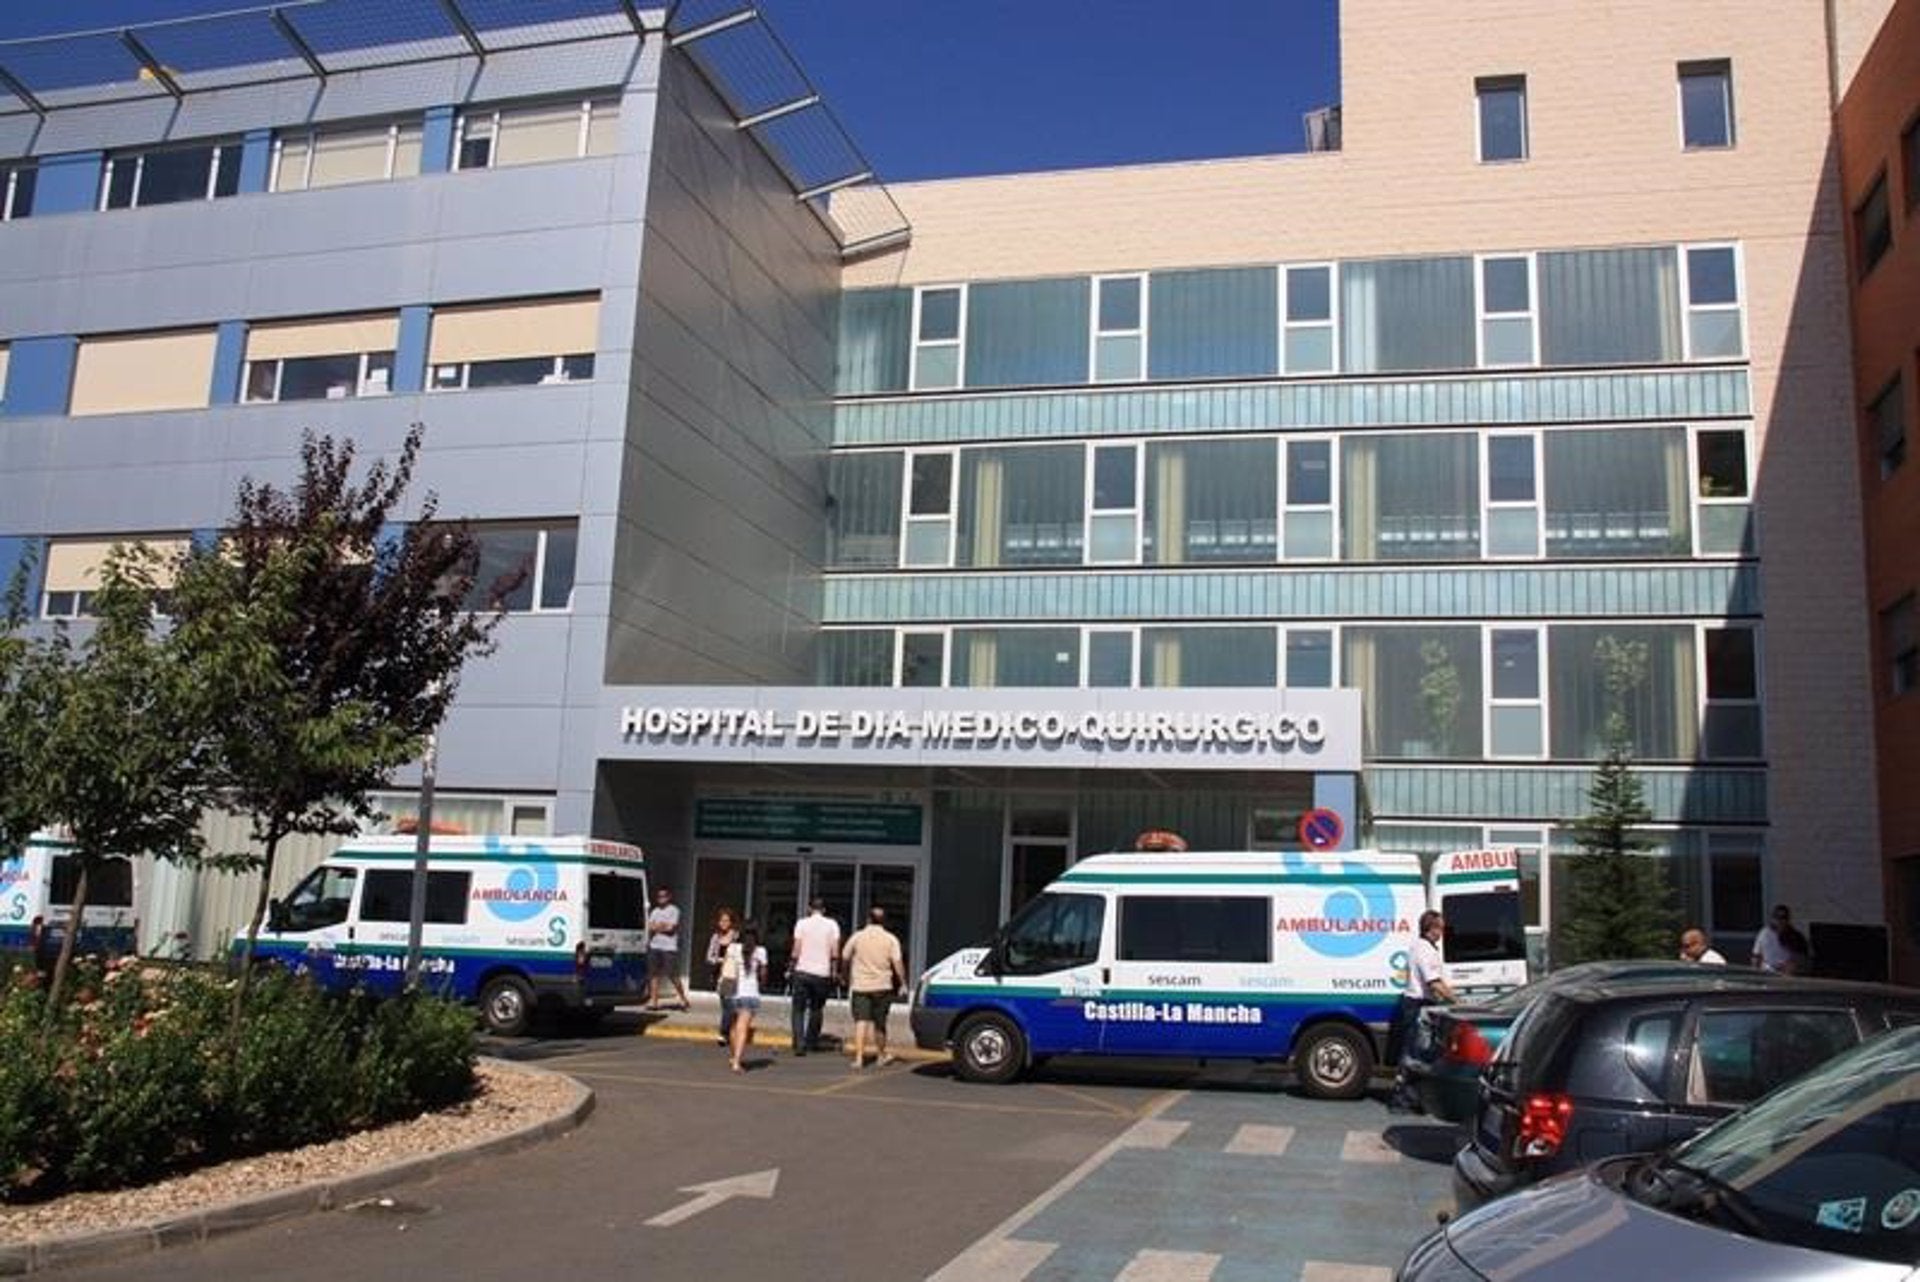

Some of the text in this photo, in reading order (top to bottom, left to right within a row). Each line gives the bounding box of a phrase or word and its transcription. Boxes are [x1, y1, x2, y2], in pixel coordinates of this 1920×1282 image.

[621, 706, 784, 738] HOSPITAL
[795, 708, 840, 739] DE
[850, 709, 911, 740] DIA
[472, 888, 568, 901] AMBULANCIA
[1276, 917, 1411, 932] AMBULANCIA
[1148, 974, 1202, 986] sescam
[1331, 978, 1387, 989] sescam
[1084, 1000, 1262, 1024] Castilla-La Mancha
